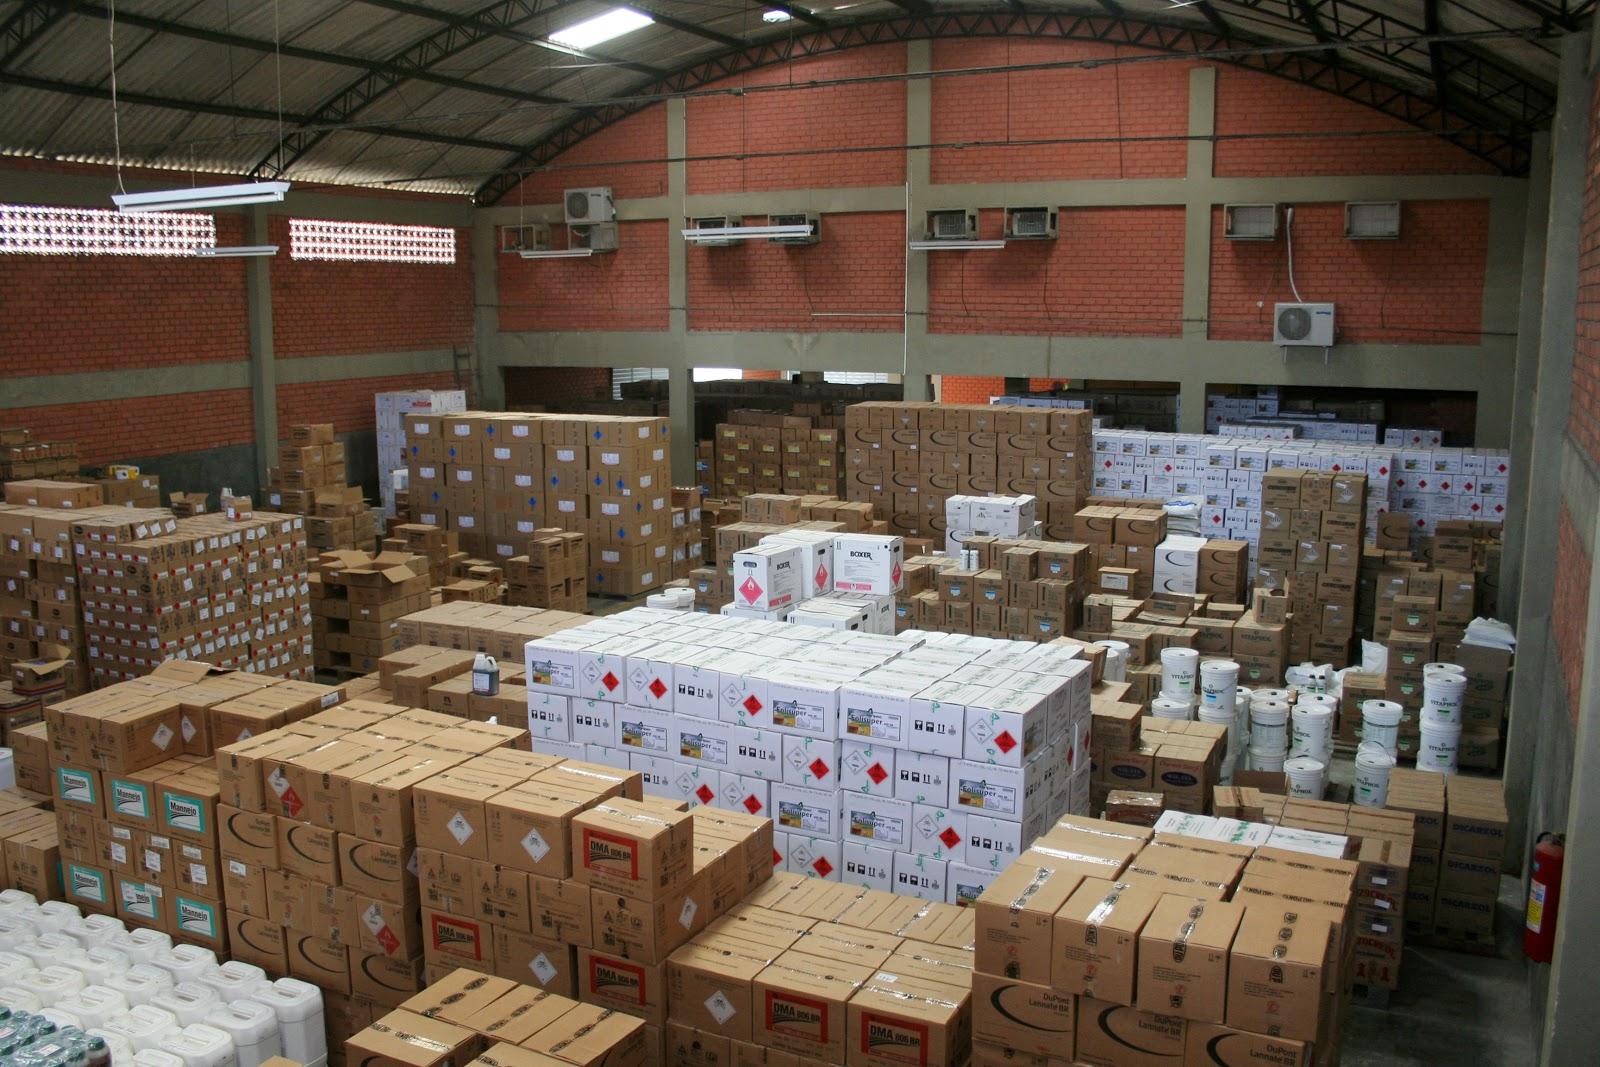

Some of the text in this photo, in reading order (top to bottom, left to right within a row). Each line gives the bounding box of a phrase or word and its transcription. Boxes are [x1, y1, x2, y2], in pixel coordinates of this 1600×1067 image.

[850, 551, 873, 560] BOXER
[776, 561, 791, 570] BOXER
[116, 789, 141, 802] Mannejo
[170, 802, 196, 816] Mannejo
[590, 841, 609, 855] DMA
[181, 906, 207, 920] Mannejo
[1028, 999, 1069, 1012] Lannate BR
[1043, 993, 1069, 1004] DuPont
[774, 1002, 795, 1016] DMA
[1154, 1014, 1182, 1027] DuPont
[870, 1025, 893, 1040] DMA
[1267, 1044, 1297, 1058] DuPont
[1250, 1051, 1296, 1067] Lannate BR
